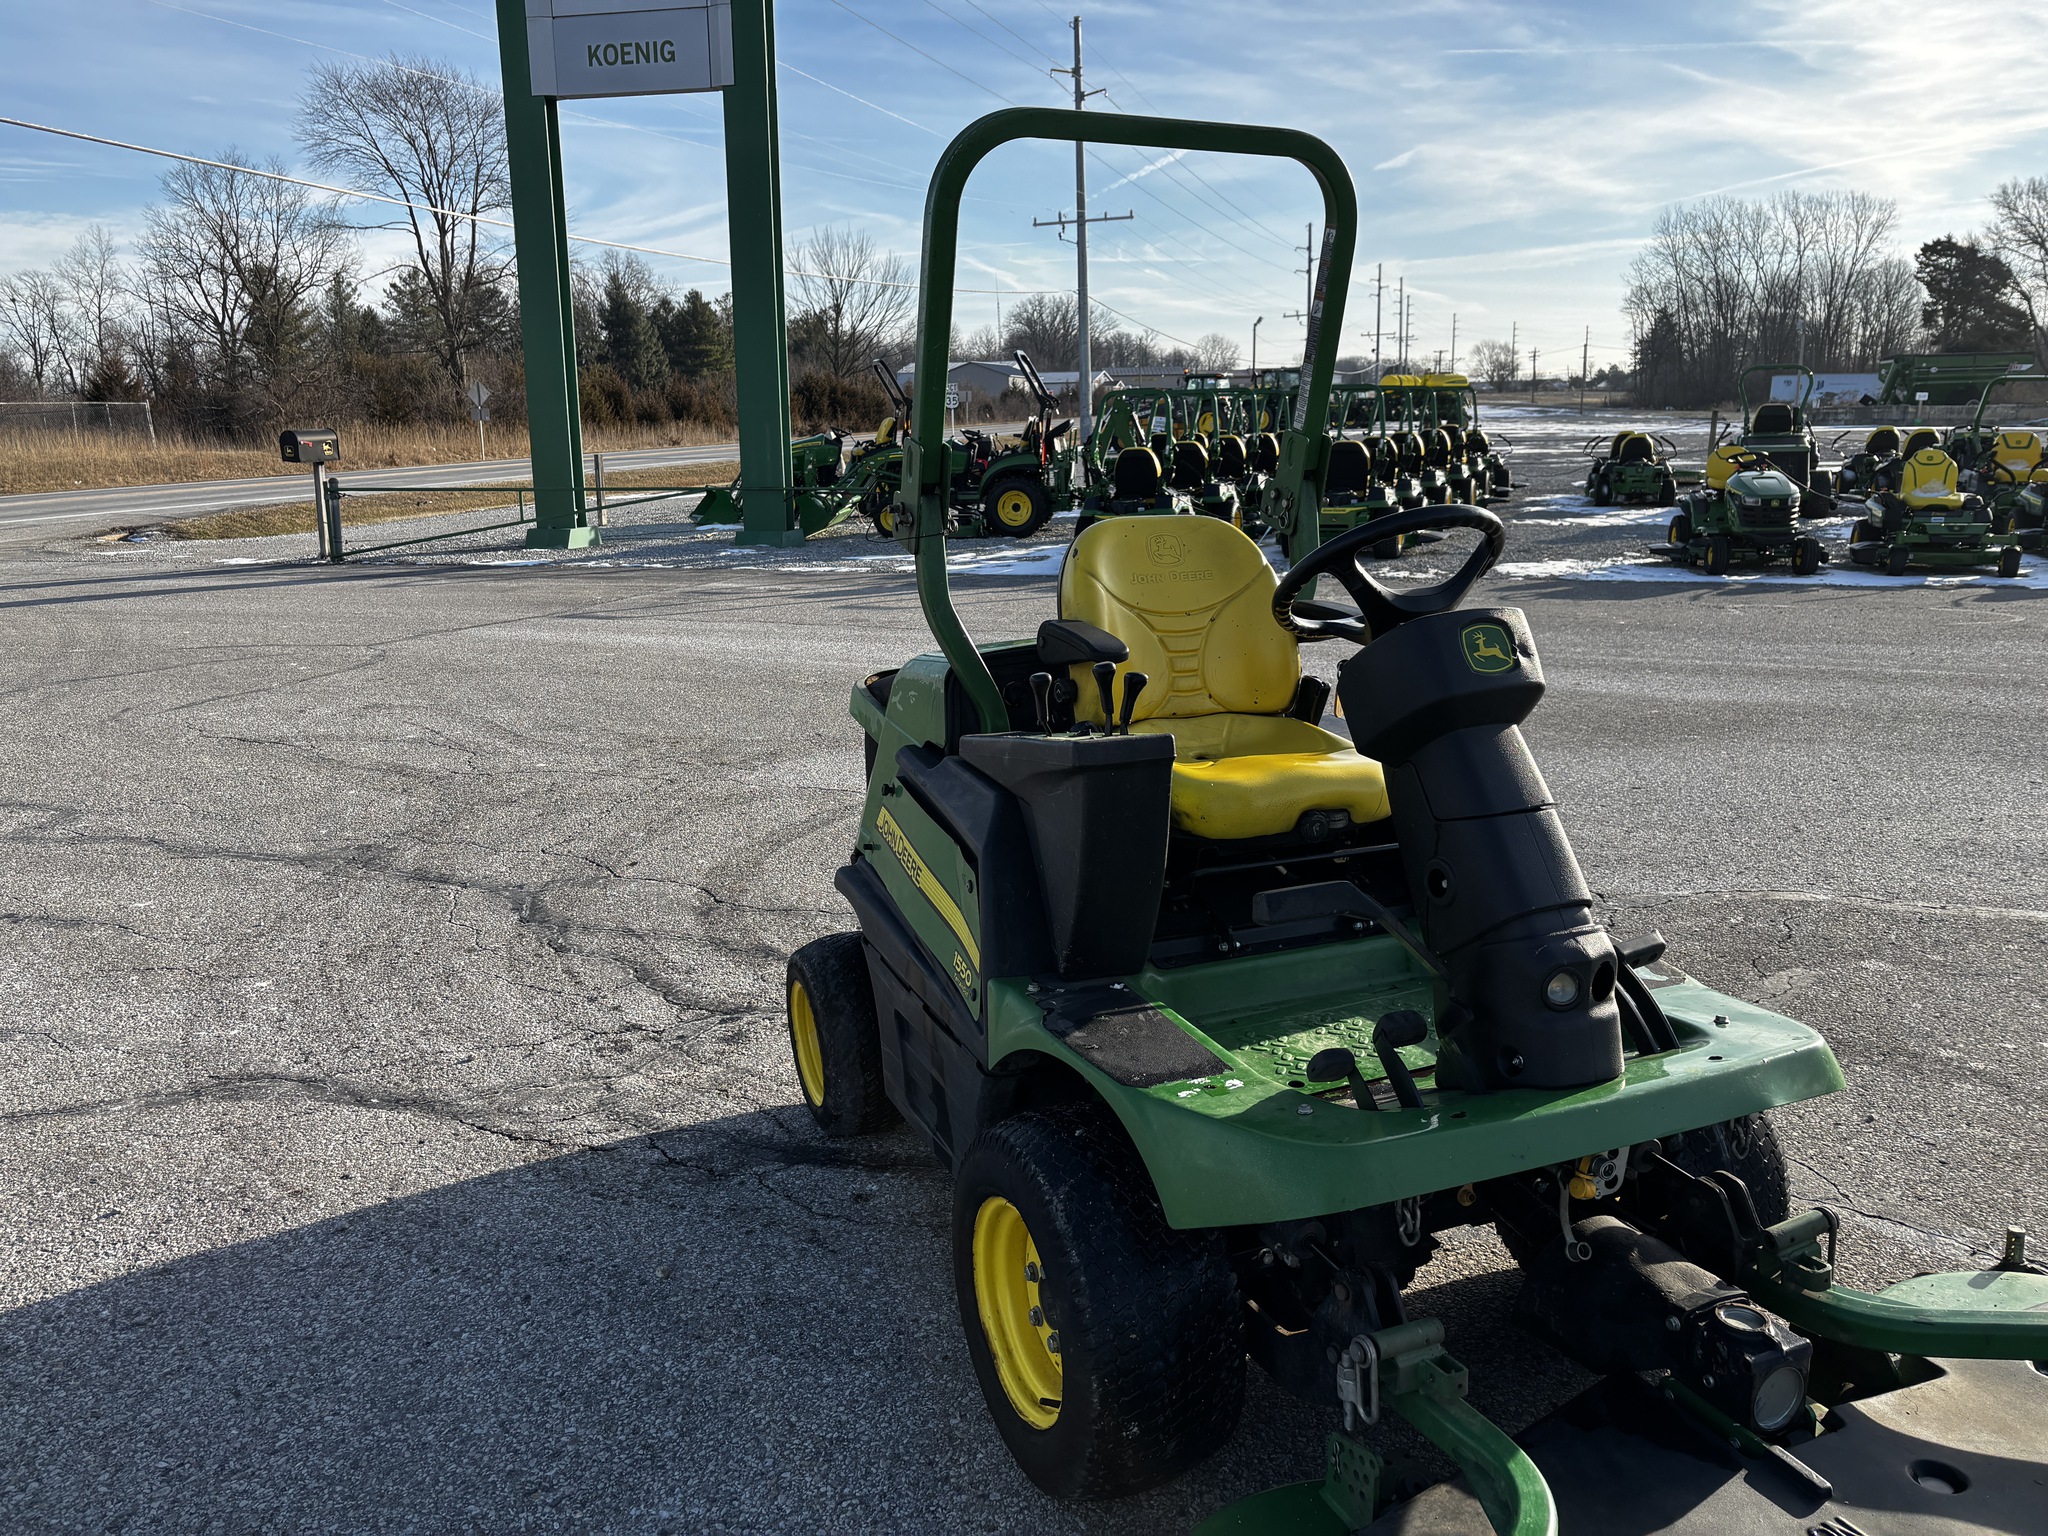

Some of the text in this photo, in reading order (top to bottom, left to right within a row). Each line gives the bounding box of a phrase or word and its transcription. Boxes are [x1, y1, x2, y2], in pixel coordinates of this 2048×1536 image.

[587, 40, 676, 67] KOENIG
[946, 396, 958, 406] 35
[1130, 569, 1213, 585] JOHN DEERE
[878, 813, 923, 885] JOHN DEERE
[953, 950, 972, 987] 1550
